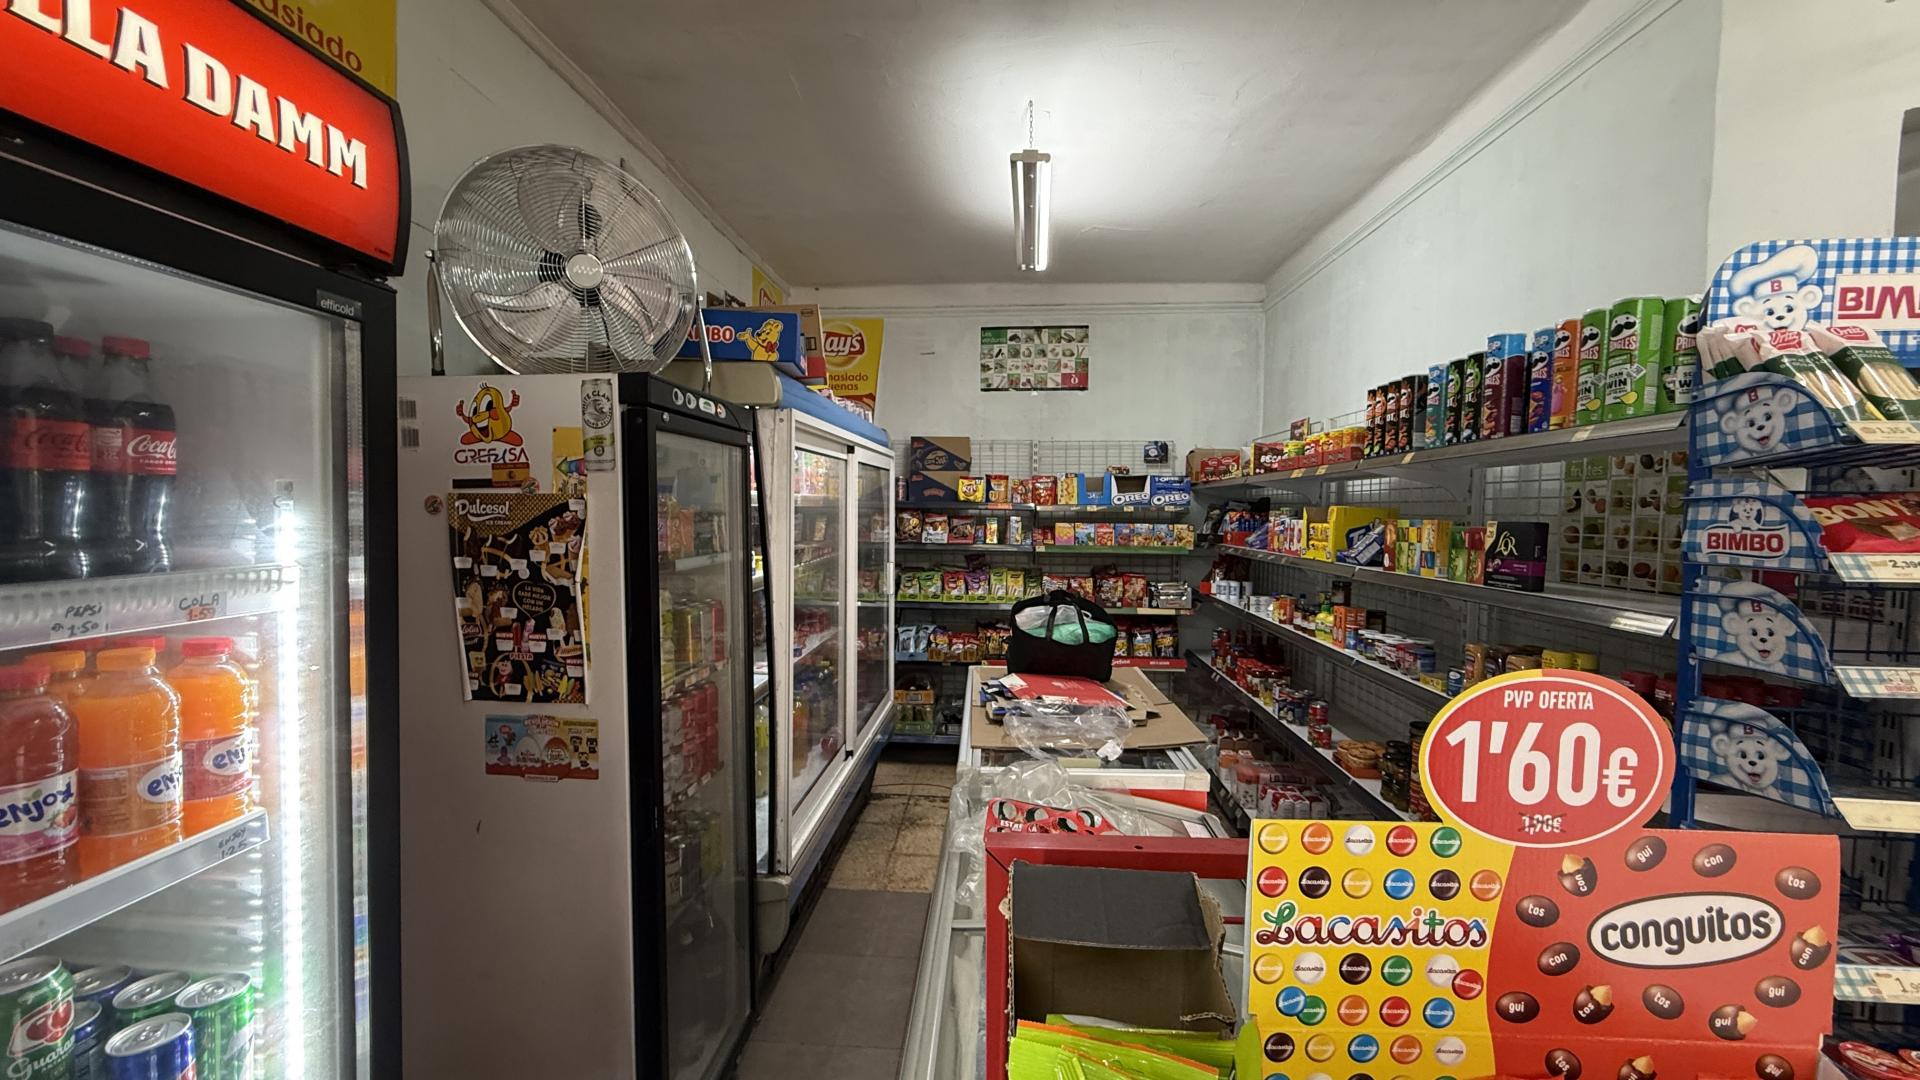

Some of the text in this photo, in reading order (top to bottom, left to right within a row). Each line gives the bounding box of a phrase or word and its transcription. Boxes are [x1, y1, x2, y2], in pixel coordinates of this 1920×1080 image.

[183, 42, 367, 189] DAMM
[1837, 286, 1920, 319] BIM
[823, 333, 862, 356] ay's
[1113, 493, 1150, 505] OREO
[1153, 493, 1189, 505] OREO
[455, 499, 509, 516] Dulcesol
[1707, 532, 1784, 553] BIMBO
[1503, 690, 1594, 711] PVP OFERTA
[1637, 847, 1653, 863] gui
[1703, 854, 1723, 867] con
[1575, 873, 1588, 892] con
[1788, 875, 1805, 889] tos
[1528, 903, 1545, 917] tos
[1256, 902, 1487, 948] Lacasitos
[1600, 905, 1773, 955] conguitos
[1549, 951, 1568, 966] con
[1799, 946, 1814, 966] con
[1768, 986, 1785, 998] gui
[1509, 1001, 1525, 1013] gui
[1654, 994, 1671, 1009] tos
[1578, 1002, 1595, 1018] tos
[1714, 1017, 1731, 1027] gui
[1554, 1056, 1570, 1072] tos
[1765, 1063, 1783, 1079] gui
